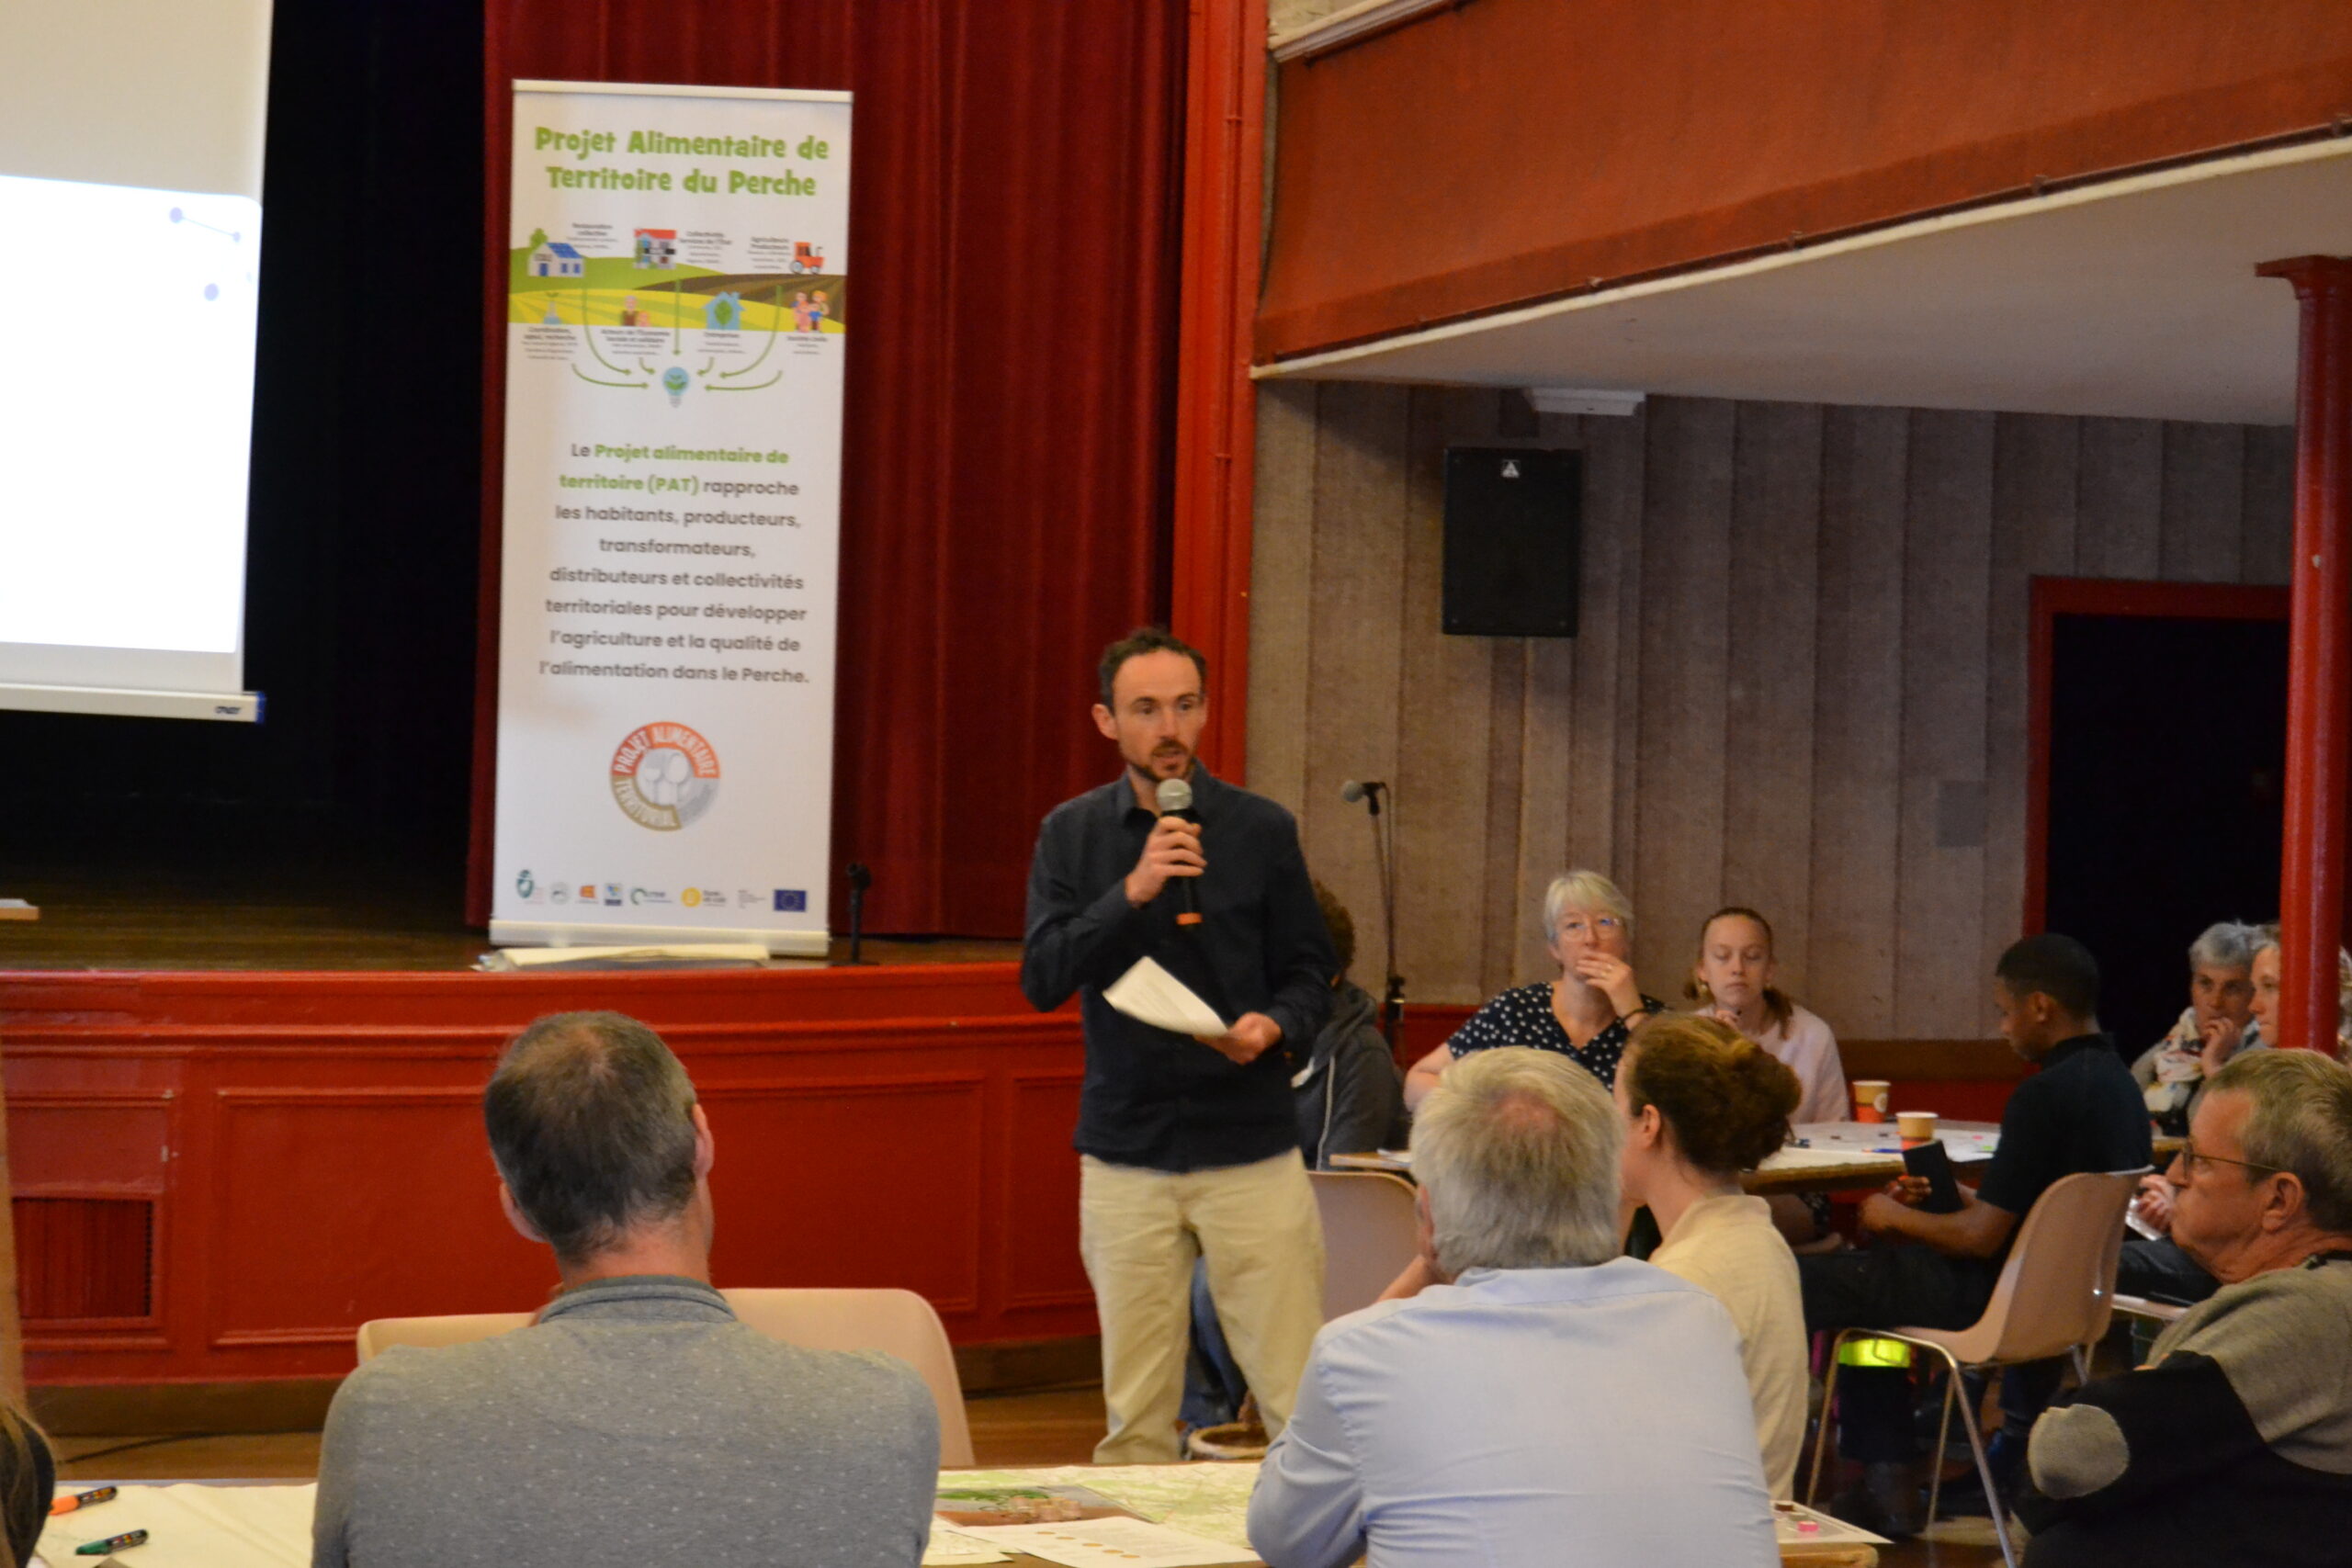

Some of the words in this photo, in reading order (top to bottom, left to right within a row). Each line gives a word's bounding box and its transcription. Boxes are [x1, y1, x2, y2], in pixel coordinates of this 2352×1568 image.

[535, 126, 616, 160] Projet
[628, 130, 786, 158] Alimentaire
[797, 135, 829, 160] de
[545, 165, 672, 190] Territoire
[684, 169, 718, 193] du
[729, 169, 816, 196] Perche
[571, 444, 591, 457] Le
[595, 444, 650, 463] Projet
[653, 446, 763, 463] alimentaire
[766, 450, 788, 463] de
[559, 474, 644, 490] territoire
[648, 475, 699, 495] (PAT)
[704, 481, 799, 497] rapproche
[555, 505, 581, 519] les
[586, 507, 678, 523] habitants,
[684, 511, 800, 527] producteurs,
[600, 539, 755, 558] transformateurs,
[548, 567, 667, 584] distributeurs
[672, 573, 689, 585] et
[694, 573, 804, 589] collectivités
[545, 599, 652, 615] territoriales
[657, 605, 699, 619] pour
[704, 604, 808, 624] développer
[667, 635, 684, 647] et
[689, 635, 706, 649] la
[709, 636, 774, 652] qualité
[777, 638, 800, 651] de
[673, 666, 718, 680] dans
[722, 668, 738, 680] le
[742, 668, 808, 682] Perche.
[613, 729, 651, 773] PROJET
